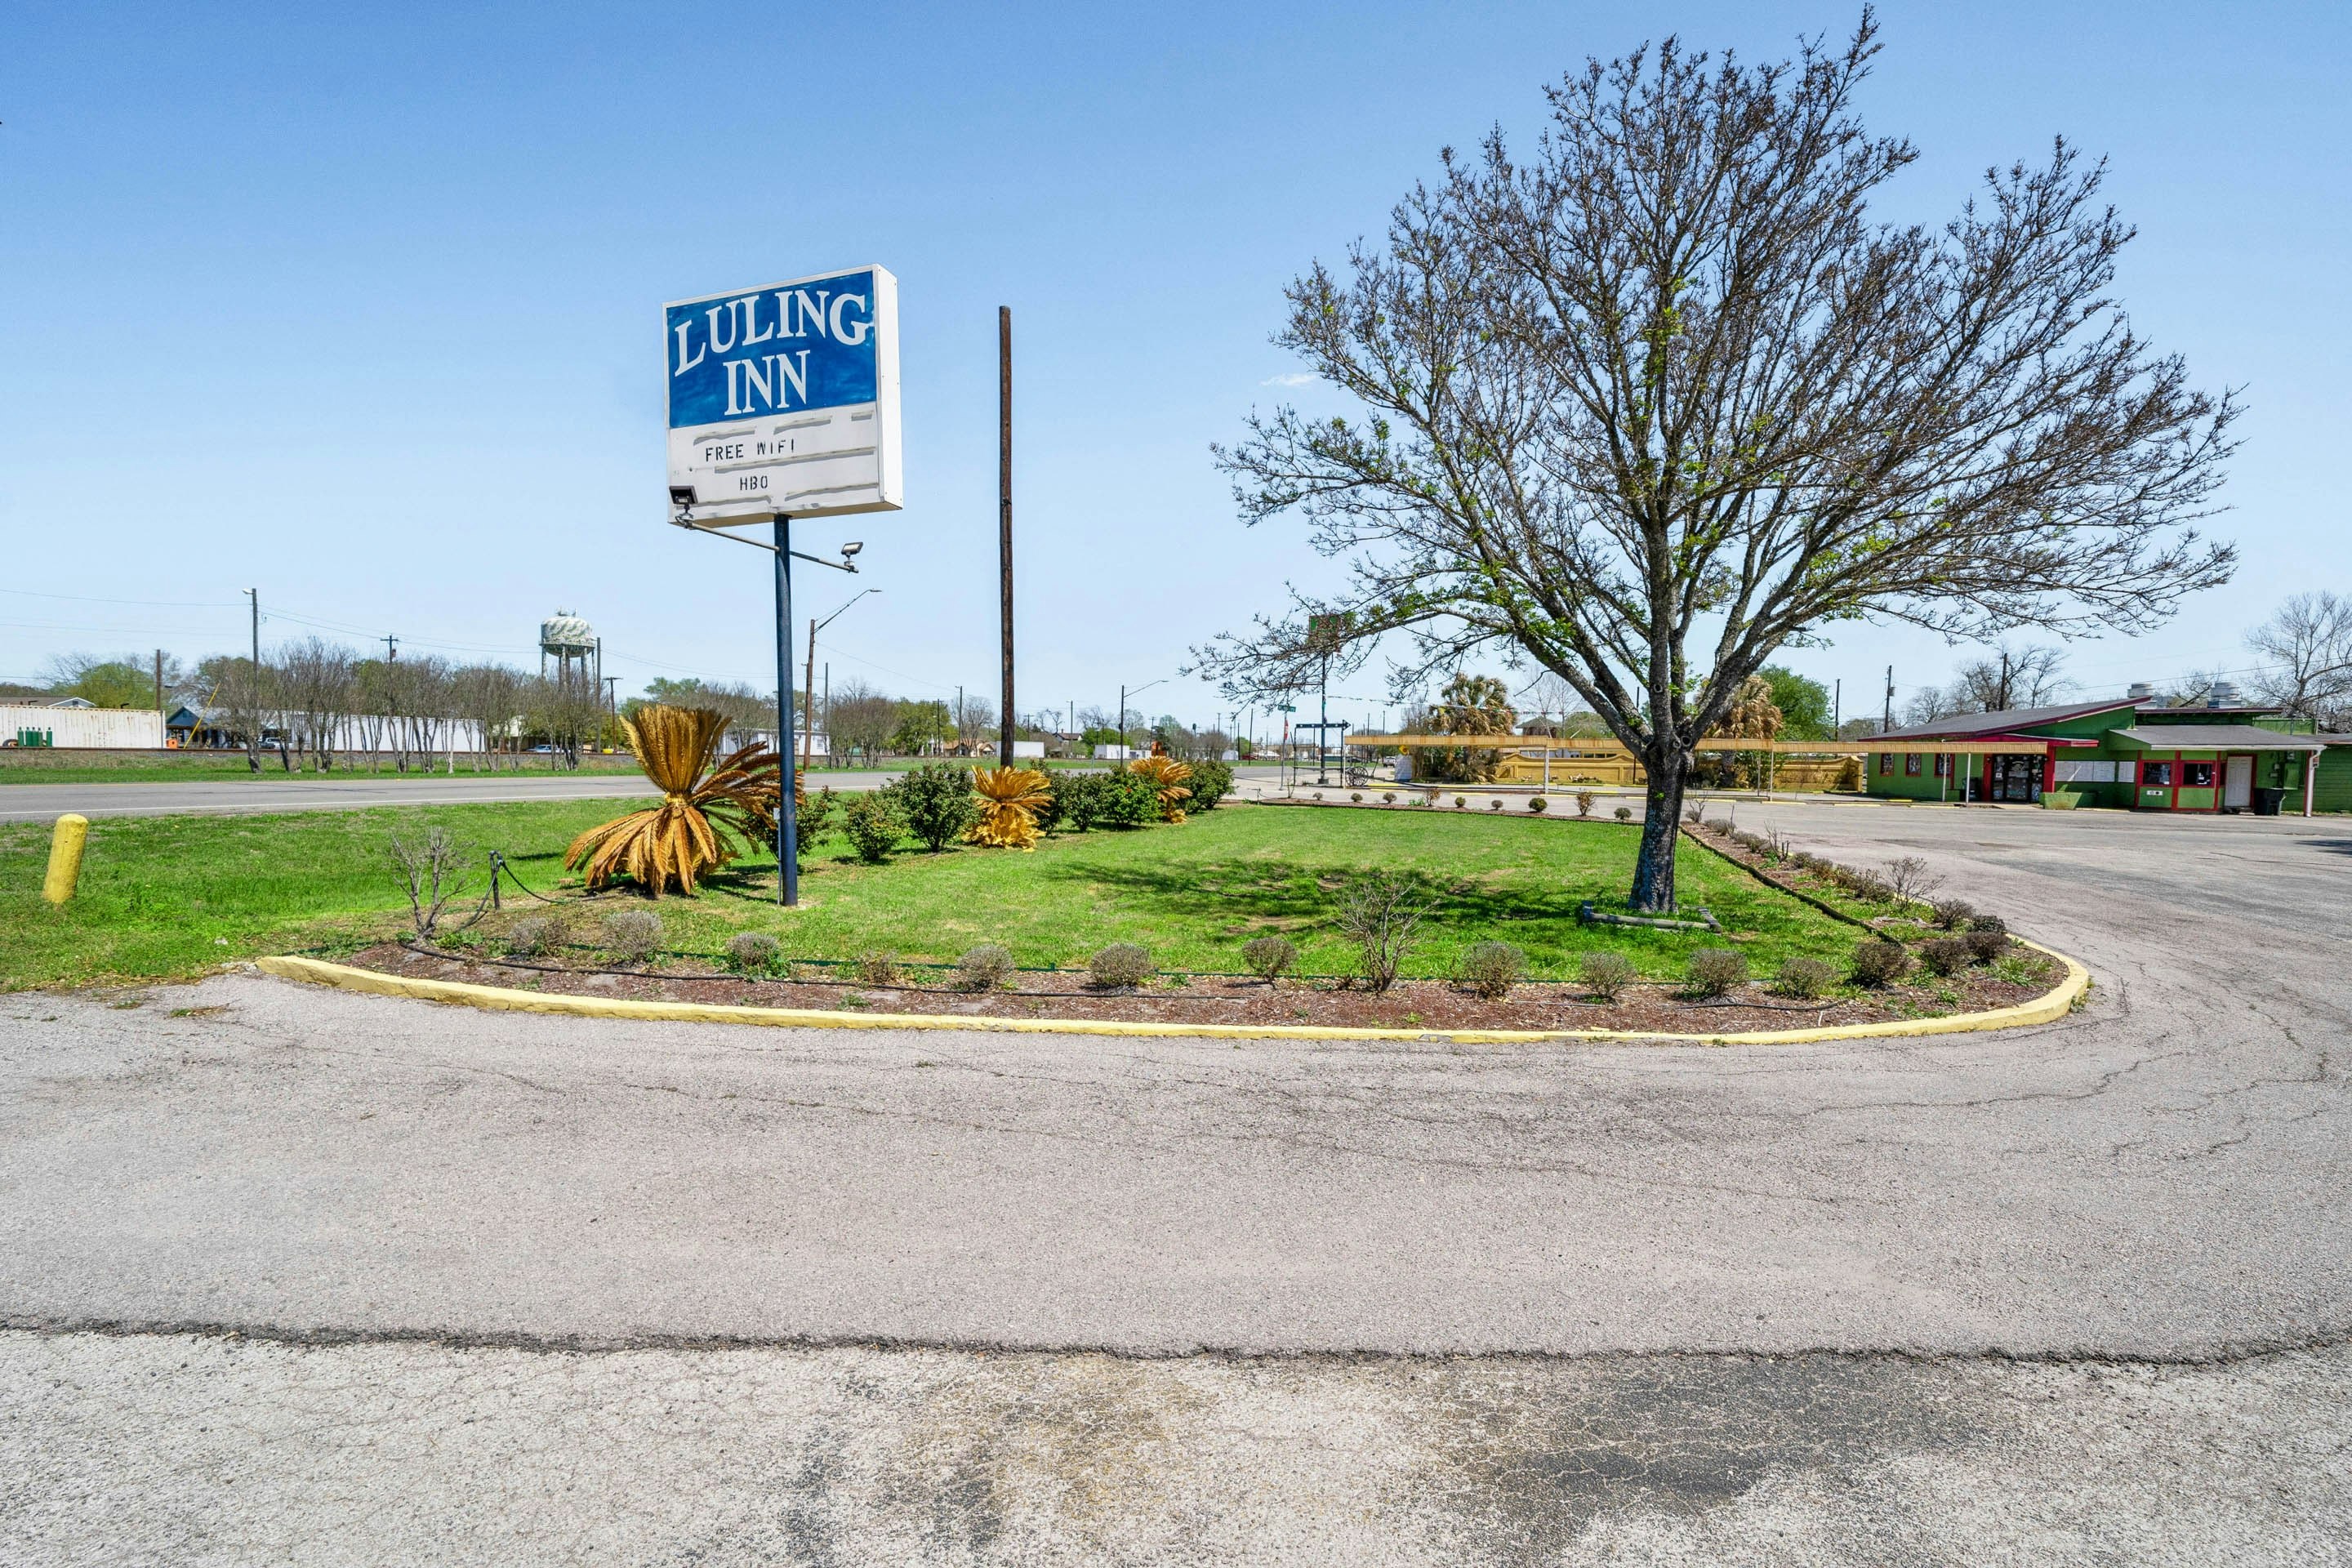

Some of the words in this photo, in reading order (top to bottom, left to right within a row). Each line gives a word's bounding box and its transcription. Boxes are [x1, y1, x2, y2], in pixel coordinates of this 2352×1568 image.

[675, 290, 871, 376] LULING
[723, 350, 811, 416] INN
[705, 443, 744, 462] FREE
[757, 439, 794, 455] WIFI
[740, 475, 768, 491] HBO
